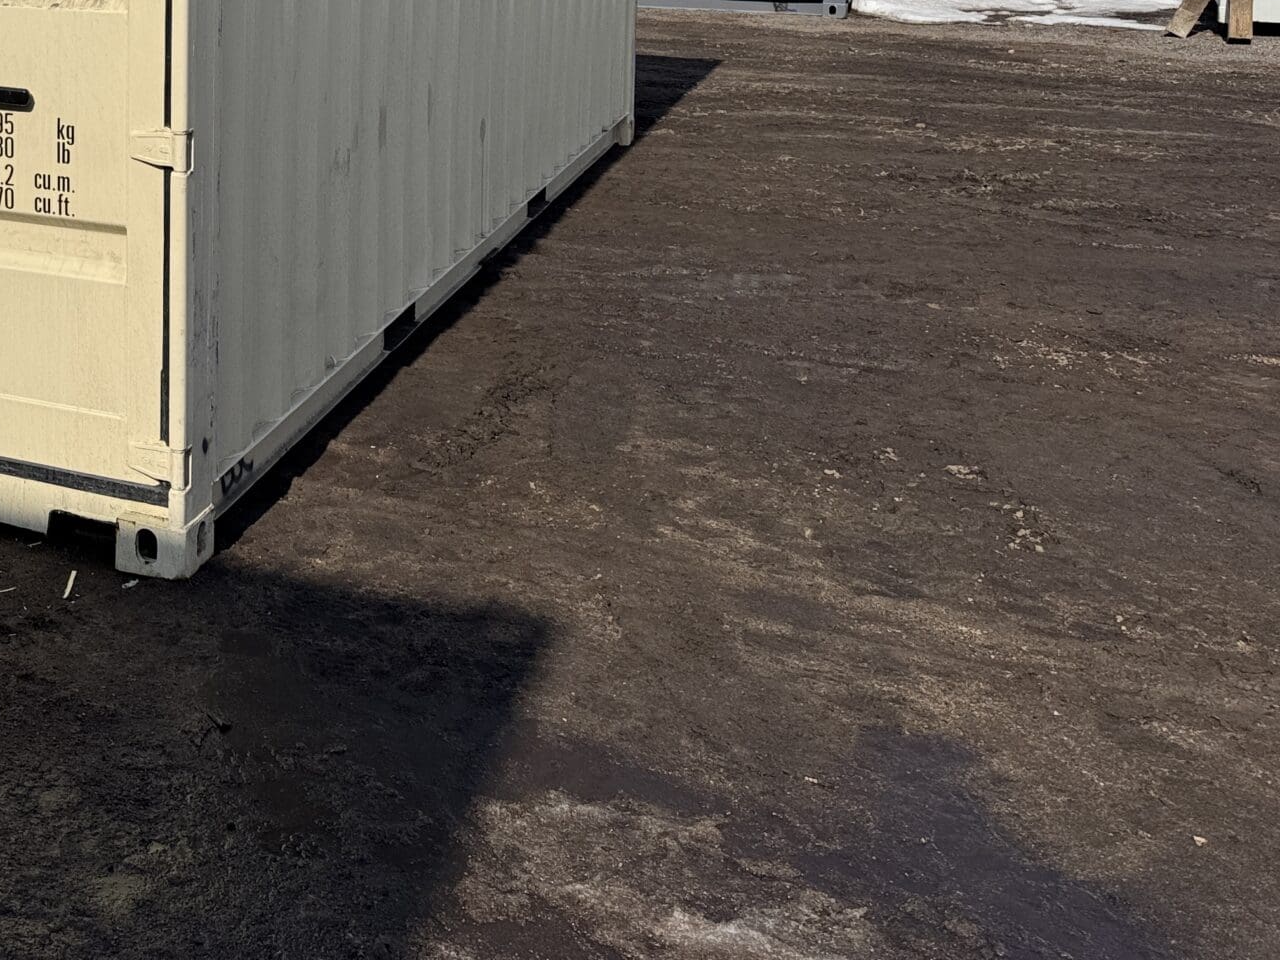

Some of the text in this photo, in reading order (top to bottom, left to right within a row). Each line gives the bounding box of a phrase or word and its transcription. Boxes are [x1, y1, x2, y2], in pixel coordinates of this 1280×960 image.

[56, 118, 75, 145] kg
[56, 142, 71, 164] lb
[34, 172, 75, 193] cu.m.
[34, 194, 75, 217] cu.ft.
